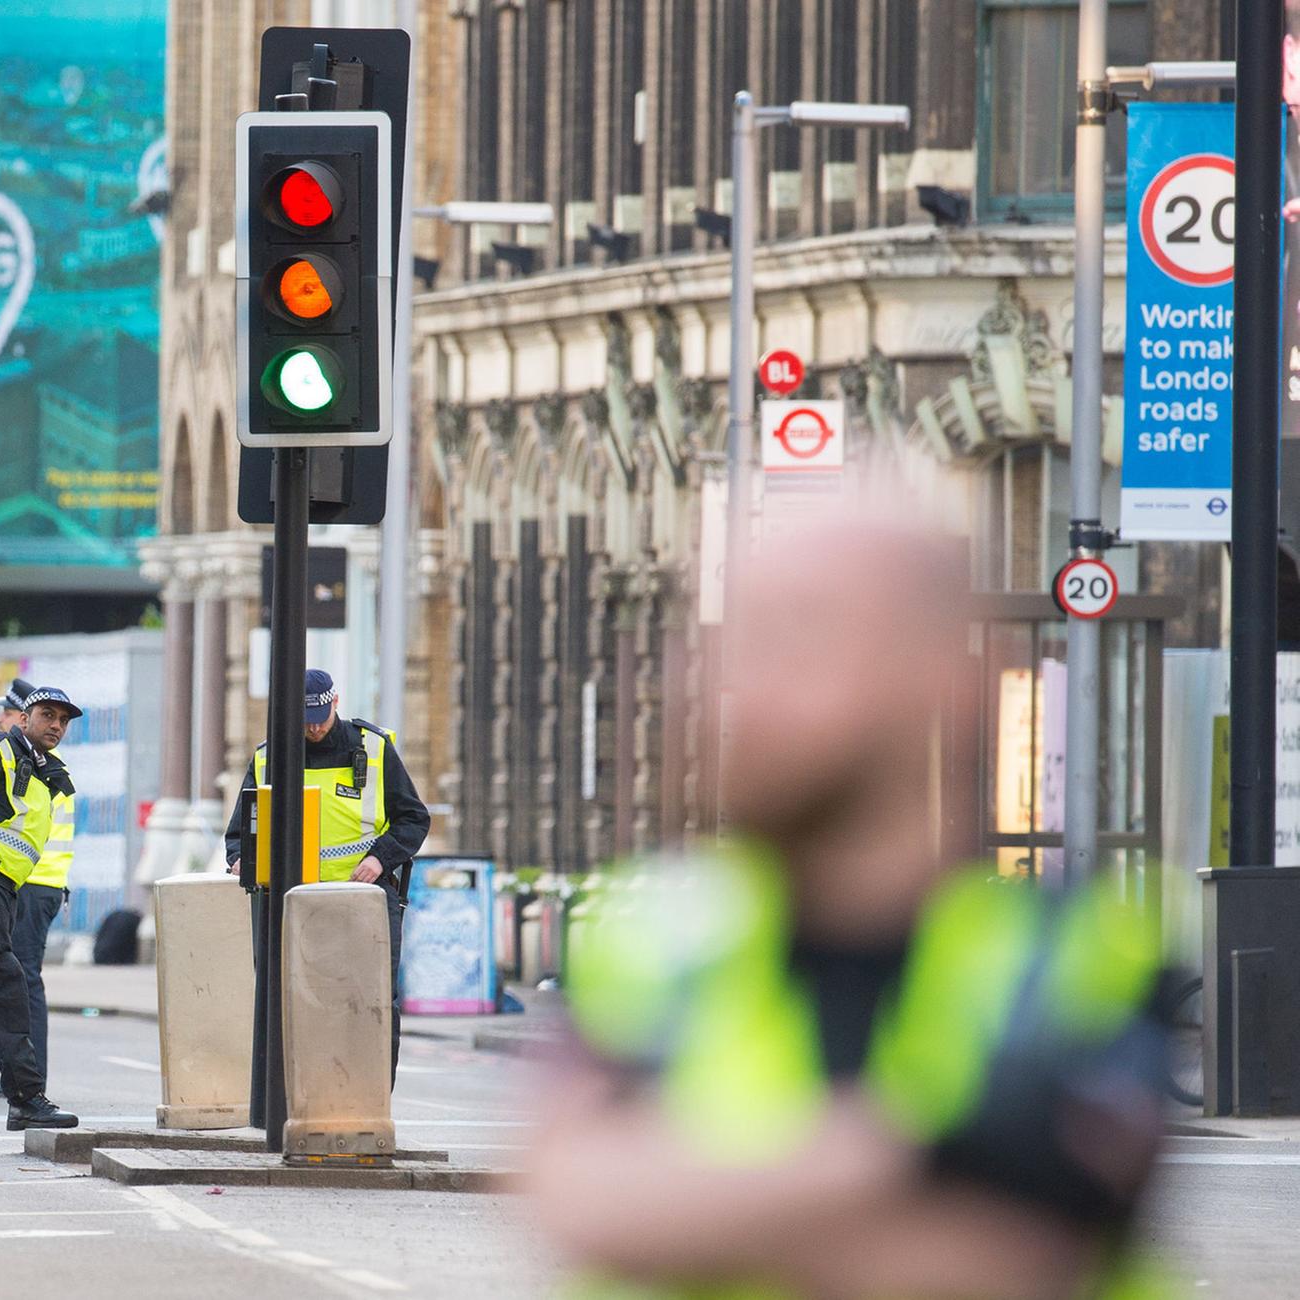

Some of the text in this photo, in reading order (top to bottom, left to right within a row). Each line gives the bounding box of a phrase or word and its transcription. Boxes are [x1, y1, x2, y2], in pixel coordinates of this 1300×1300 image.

[1140, 336, 1172, 359] to
[767, 360, 797, 384] BL
[1140, 365, 1233, 391] Londo
[1140, 396, 1219, 422] roads
[1138, 426, 1211, 453] safer
[1068, 577, 1108, 600] 20
